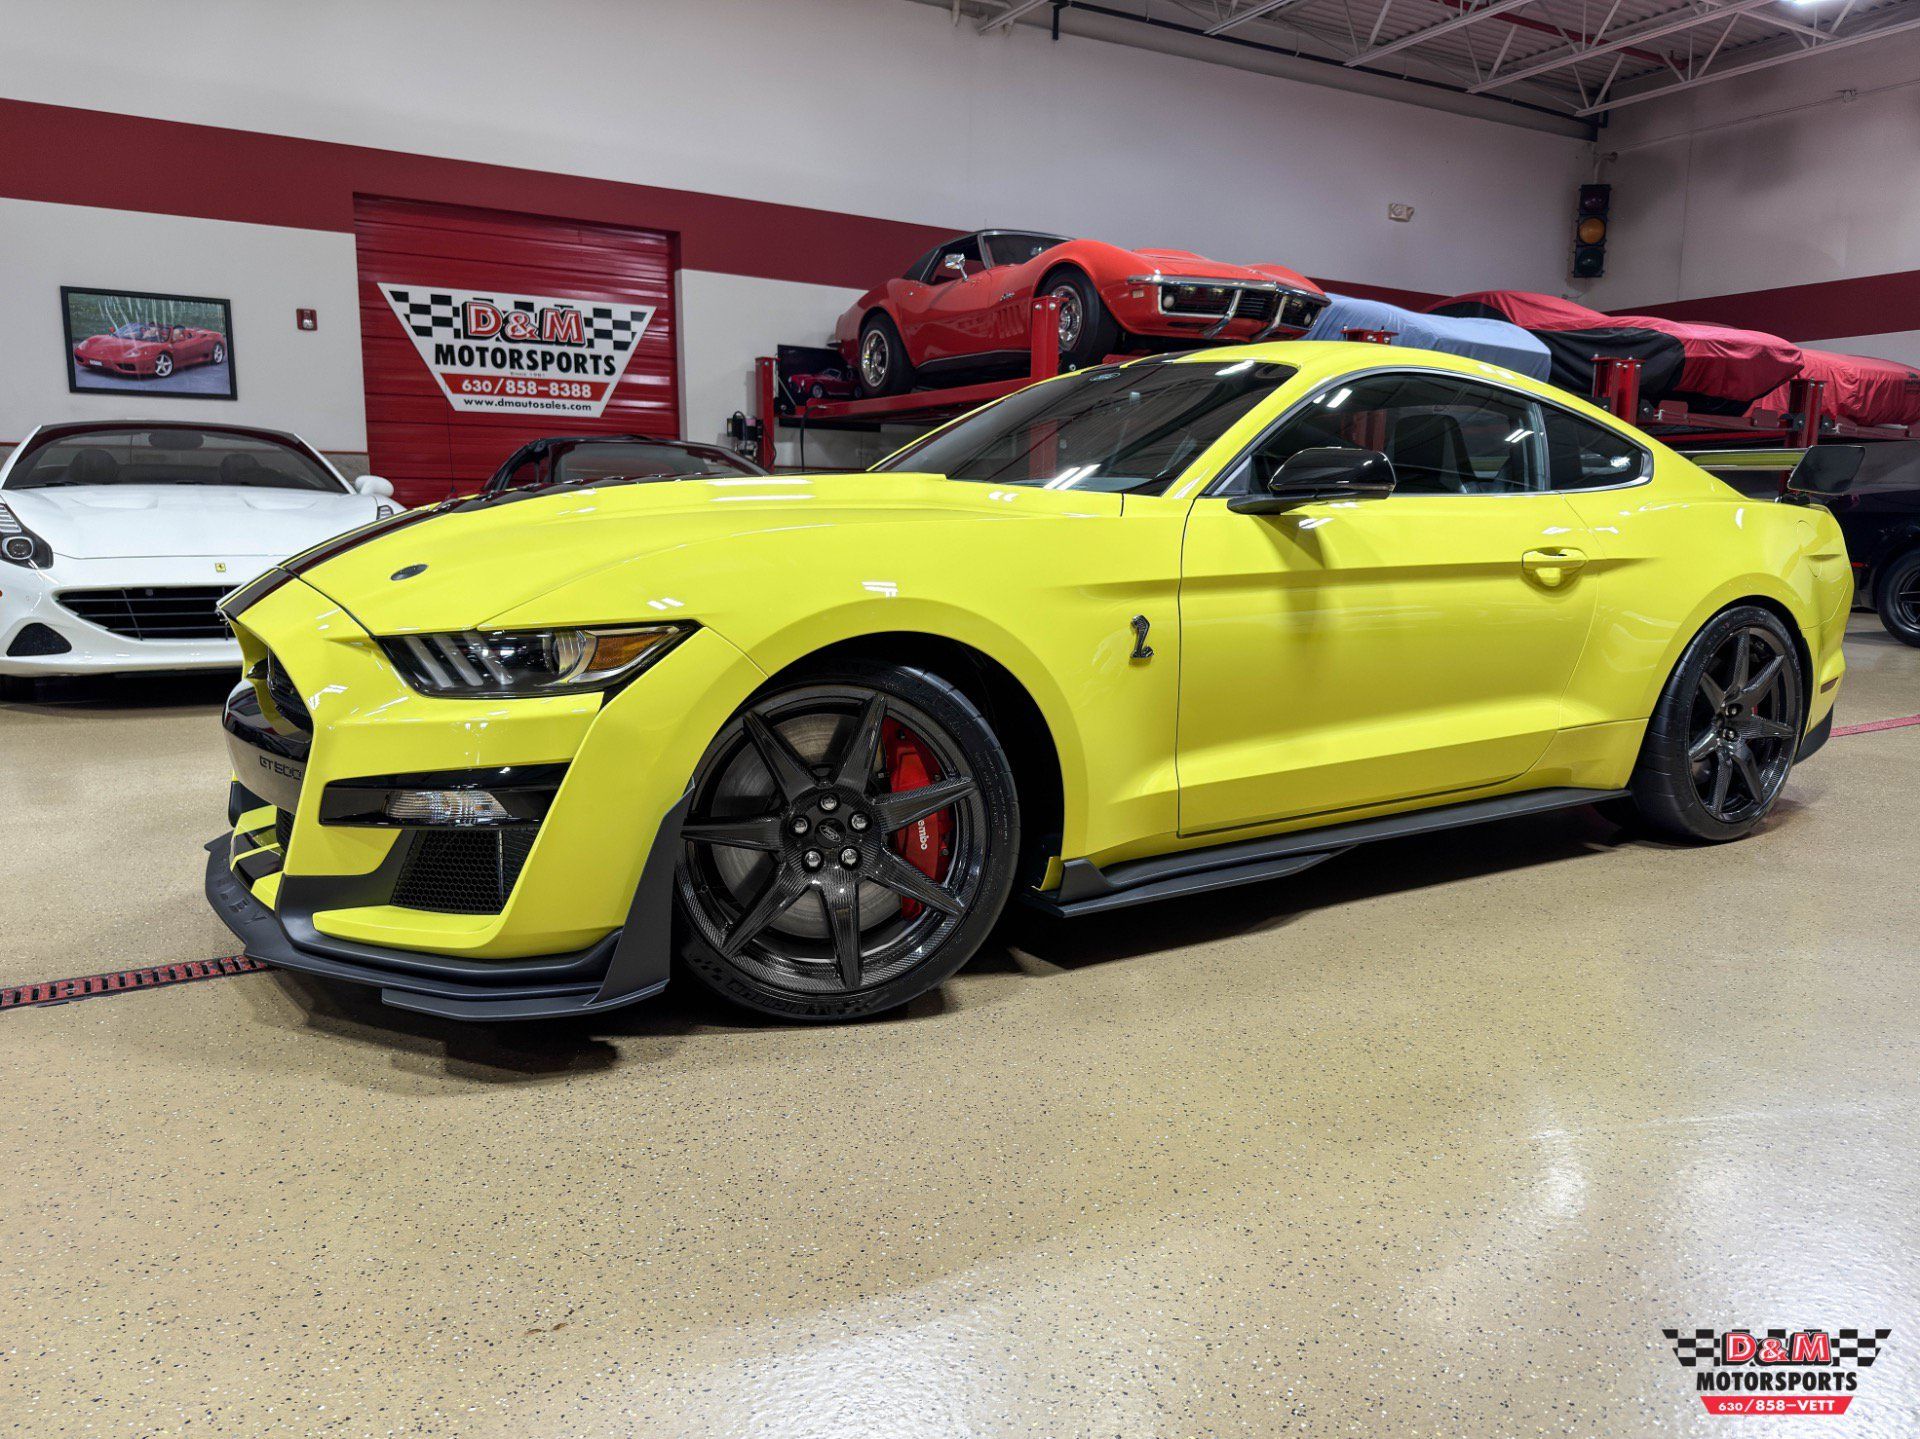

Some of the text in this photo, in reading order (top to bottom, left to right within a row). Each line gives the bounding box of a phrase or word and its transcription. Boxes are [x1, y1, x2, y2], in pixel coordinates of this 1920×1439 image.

[462, 300, 586, 348] D&M
[434, 343, 616, 376] MOTORSPORTS
[463, 397, 592, 412] www.dmautosales.com
[917, 820, 929, 850] embo
